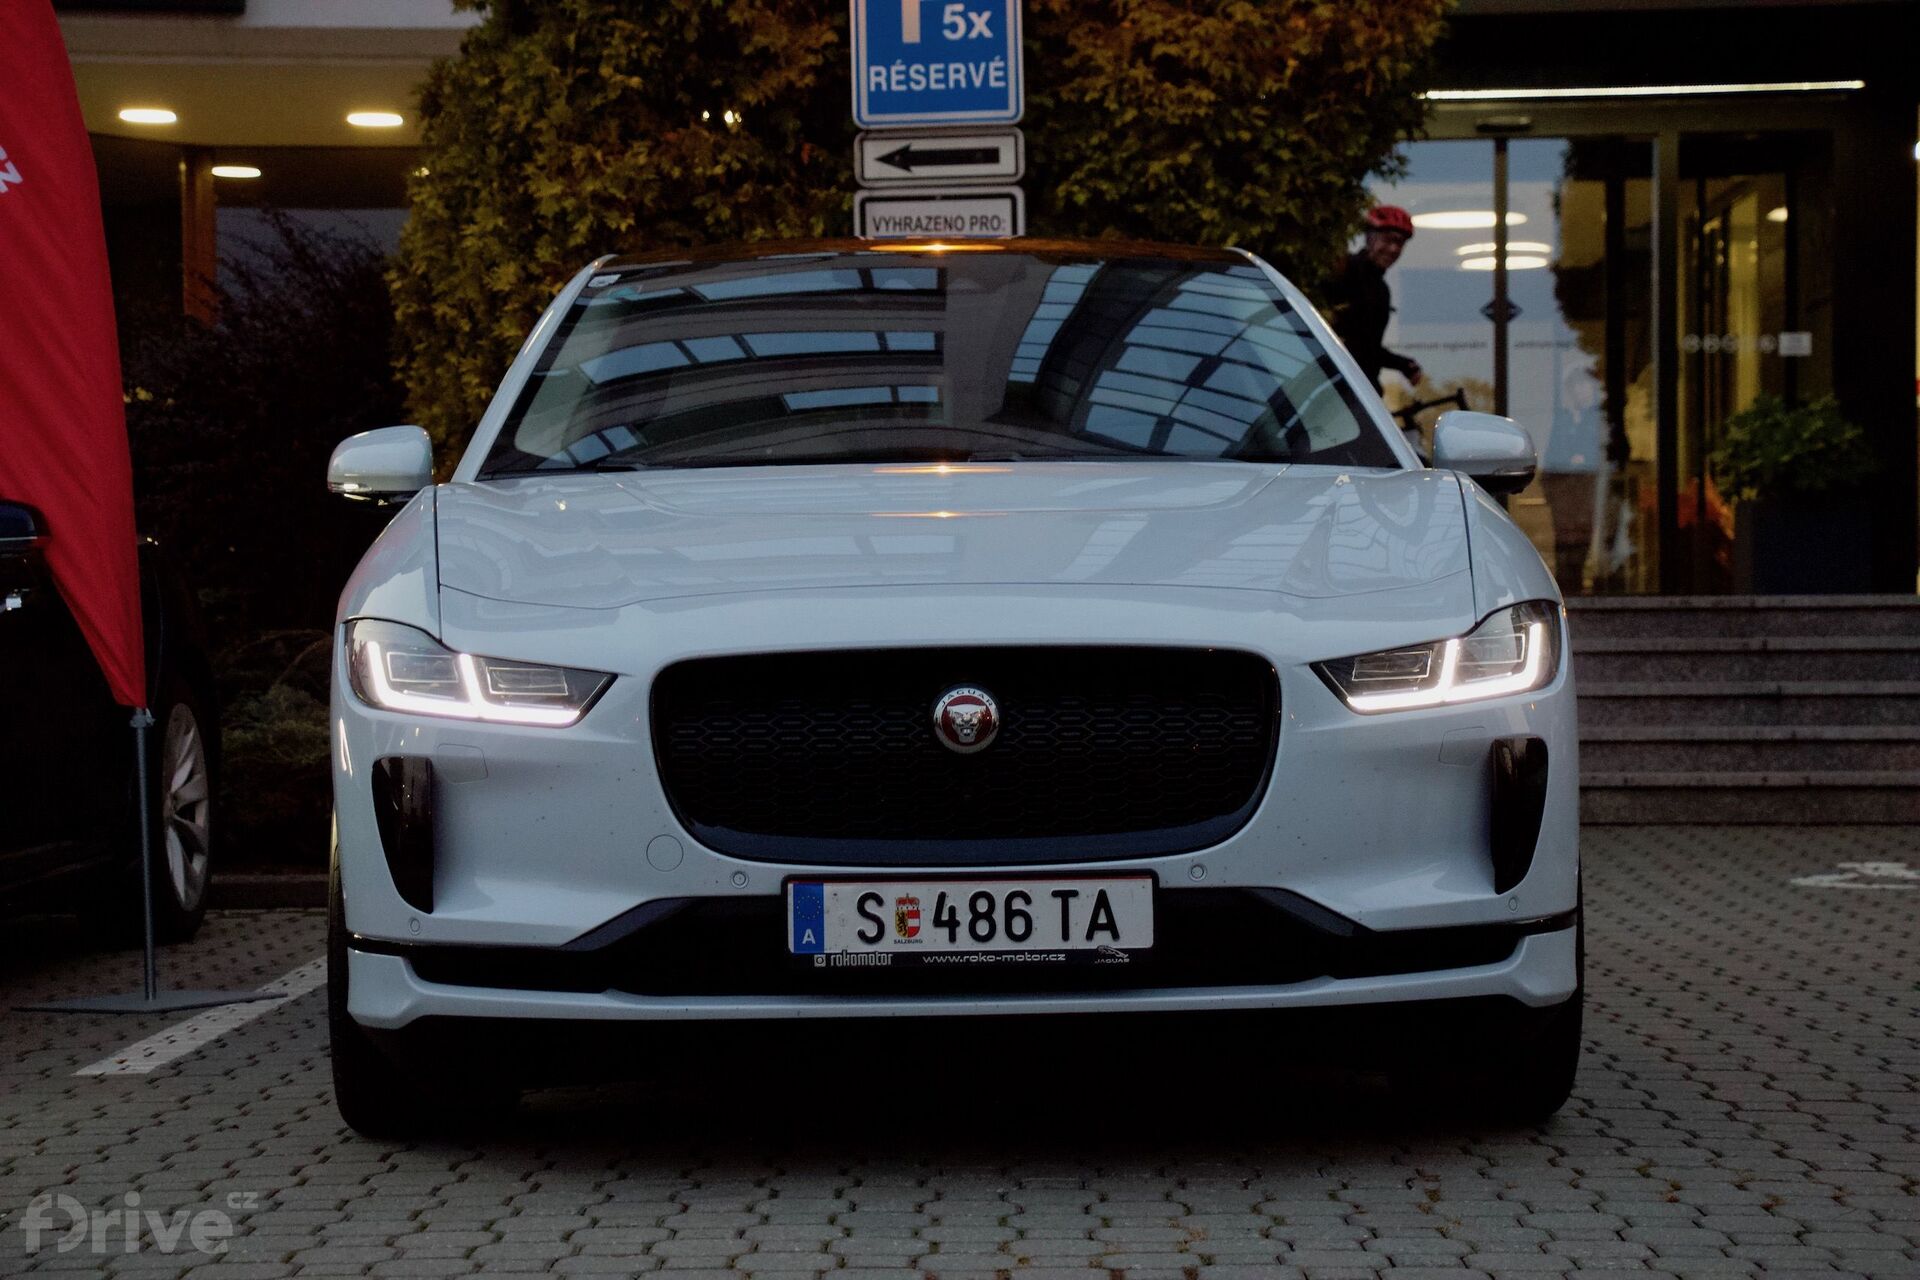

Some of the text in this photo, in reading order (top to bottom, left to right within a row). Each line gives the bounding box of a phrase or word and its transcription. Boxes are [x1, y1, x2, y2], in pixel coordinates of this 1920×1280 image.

[942, 3, 994, 41] 5x
[868, 55, 1007, 92] RÉSERVÉ
[872, 214, 966, 233] VYHRAZENO
[940, 688, 994, 708] JAGUAR
[856, 888, 1121, 945] S 486 TA
[802, 928, 816, 944] A
[830, 952, 893, 966] rokomotor
[922, 952, 1067, 964] www.roko-motor.cz
